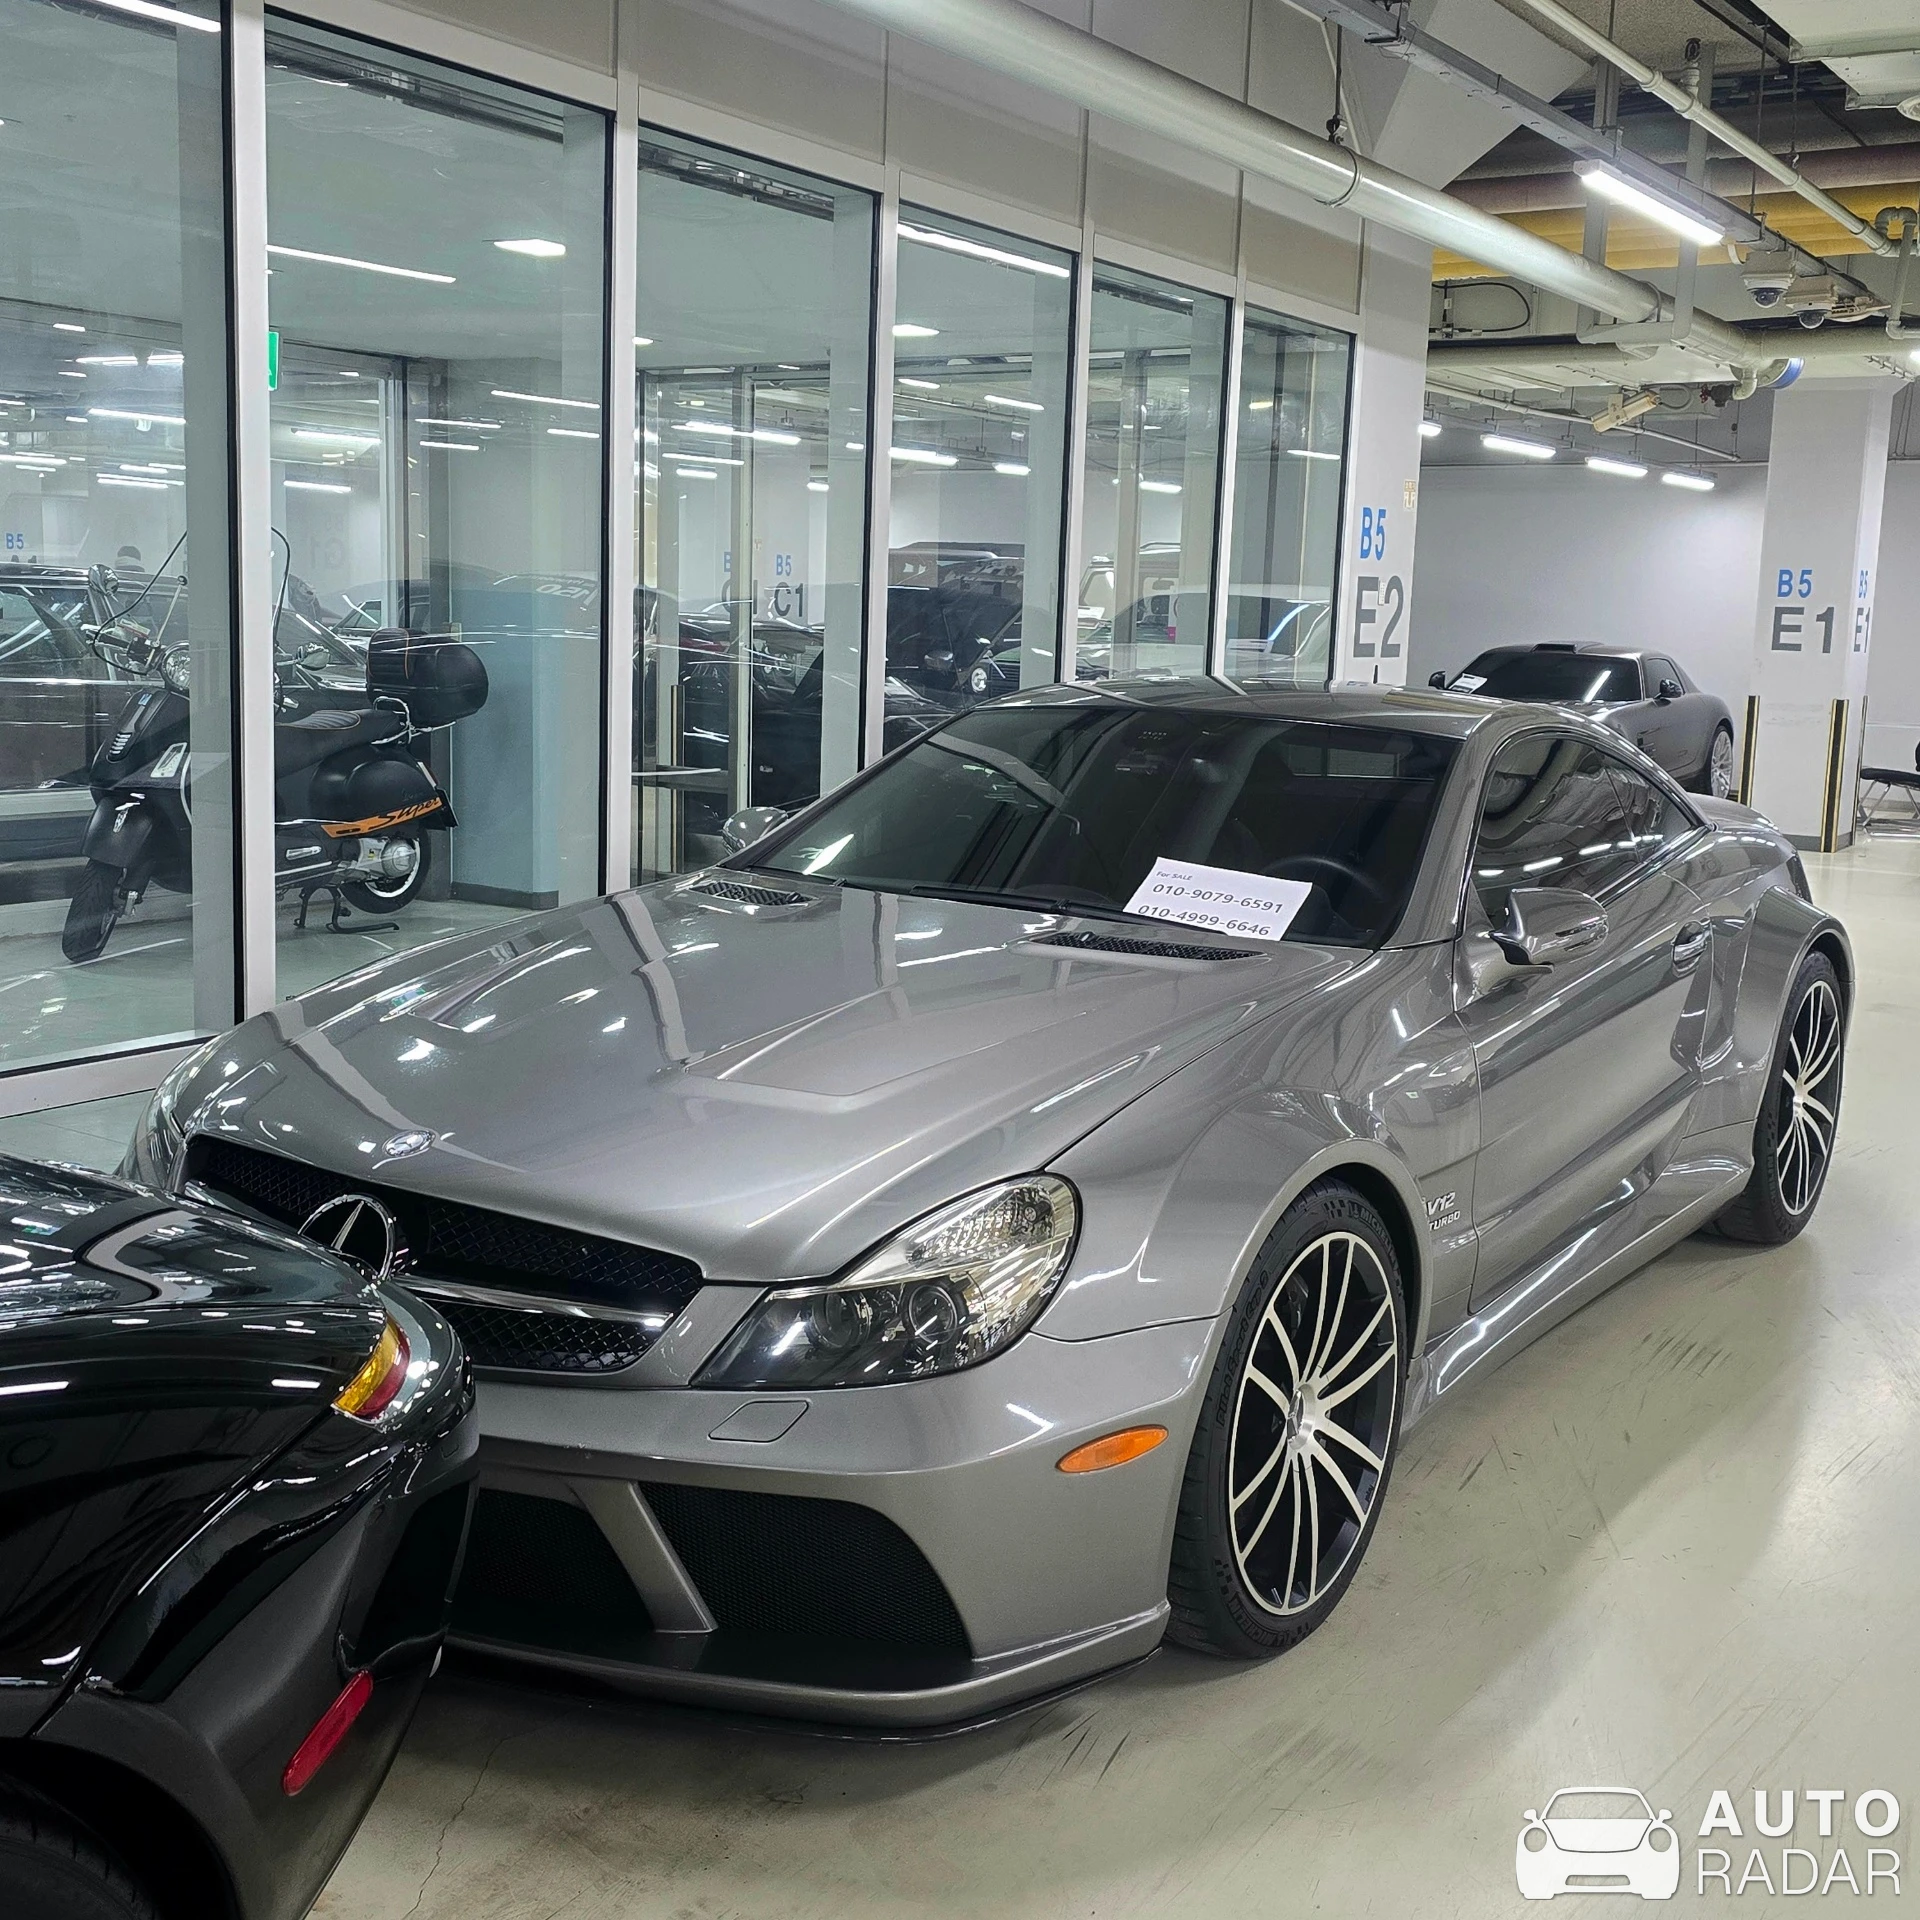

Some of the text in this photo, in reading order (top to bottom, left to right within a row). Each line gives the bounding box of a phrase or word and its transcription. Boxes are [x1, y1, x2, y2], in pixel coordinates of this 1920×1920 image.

[6, 533, 24, 549] B5
[1360, 507, 1387, 561] B5
[723, 552, 731, 573] B
[776, 554, 792, 577] B5
[1777, 569, 1813, 598] B5
[1858, 569, 1869, 599] B5
[774, 581, 804, 617] C1
[1353, 575, 1404, 658] E2
[1771, 606, 1835, 654] E1
[1853, 606, 1871, 653] E1
[367, 798, 440, 831] Super
[1156, 870, 1193, 881] For SALE
[1152, 883, 1284, 914] 010-9079-6591
[1137, 904, 1271, 936] 010-4999-6646
[1426, 1190, 1456, 1216] V12
[1429, 1209, 1461, 1232] TURBO
